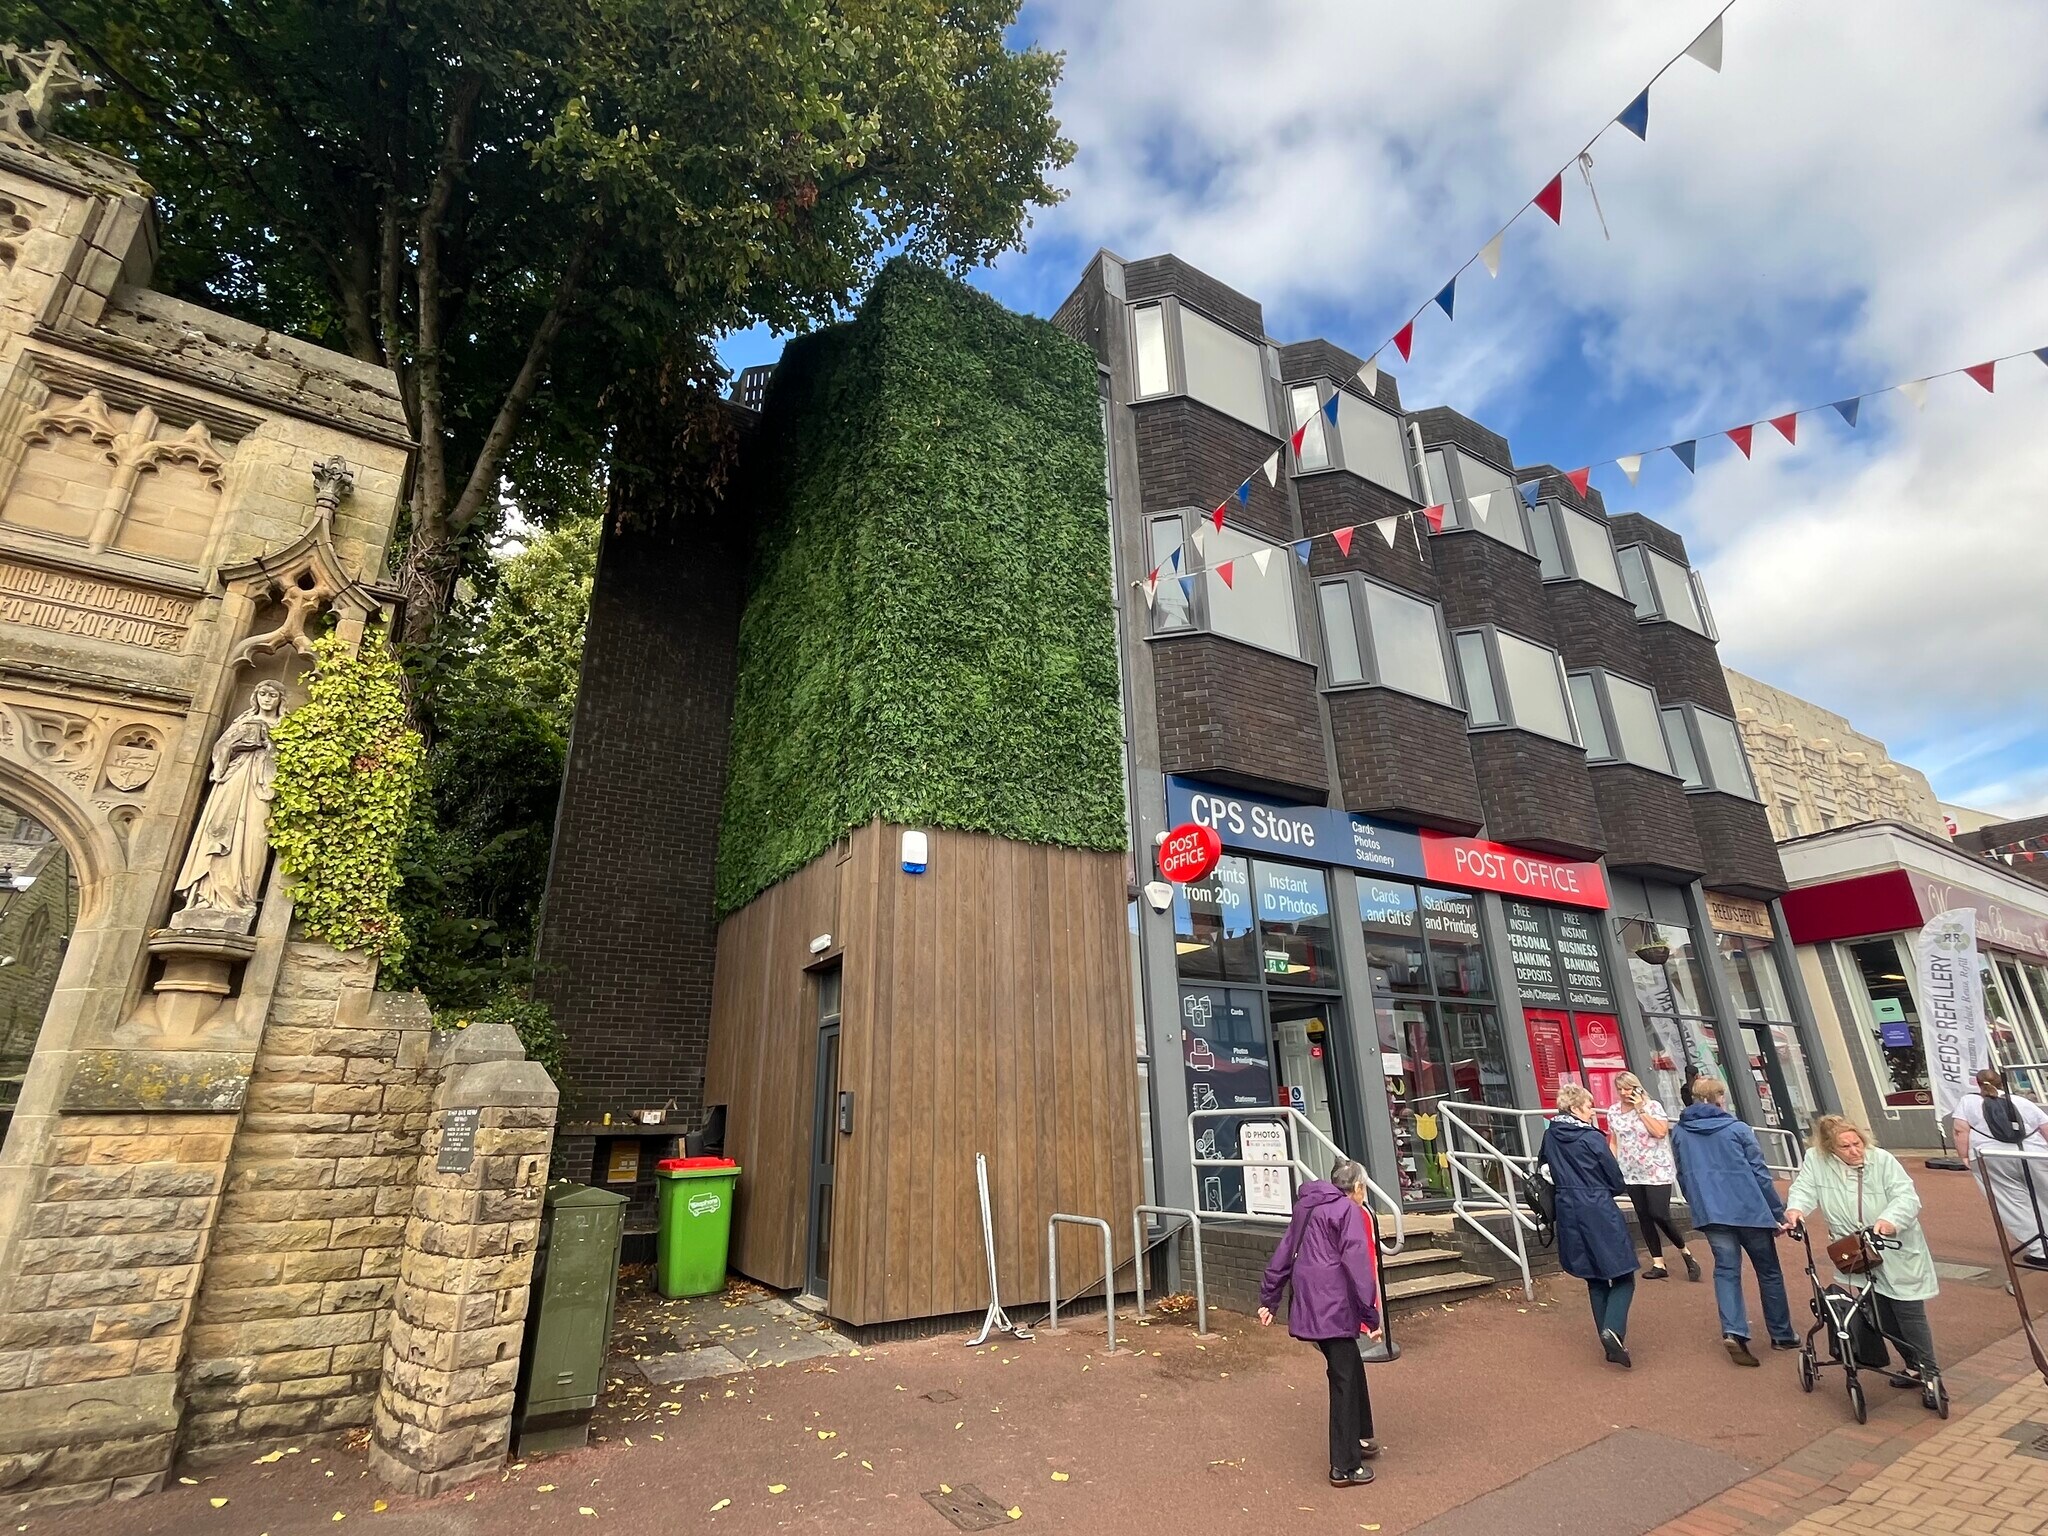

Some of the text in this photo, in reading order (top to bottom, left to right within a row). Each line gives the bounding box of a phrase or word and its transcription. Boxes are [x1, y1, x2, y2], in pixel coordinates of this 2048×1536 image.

[1191, 794, 1315, 847] CPS Store
[1351, 820, 1375, 836] Cards
[1169, 832, 1199, 854] POST
[1354, 836, 1381, 850] Photos
[1164, 847, 1205, 872] OFFICE
[1355, 848, 1395, 867] Stationery
[1455, 847, 1580, 894] POST OFFICE
[1269, 872, 1308, 893] Instant
[1181, 883, 1240, 909] from 20p
[1263, 893, 1319, 916] ID Photos
[1371, 887, 1400, 905] Cards
[1424, 895, 1471, 919] Stationery
[1512, 903, 1531, 918] FREE
[1367, 907, 1412, 927] and Gifts
[1562, 912, 1581, 926] FREE
[1425, 916, 1479, 938] and Printing
[1510, 919, 1538, 933] INSTANT
[1560, 926, 1588, 940] INSTANT
[1558, 940, 1598, 957] BUSINESS
[1512, 951, 1551, 967] BANKING
[1563, 957, 1600, 973] BANKING
[1517, 968, 1553, 983] DEPOSITS
[1568, 973, 1602, 988] DEPOSITS
[1518, 988, 1560, 1002] Cash/Cheques
[1569, 992, 1609, 1006] Cash/Cheques
[1931, 954, 1961, 1085] REED'S REFILLERY
[1253, 1131, 1280, 1139] PHOTOS
